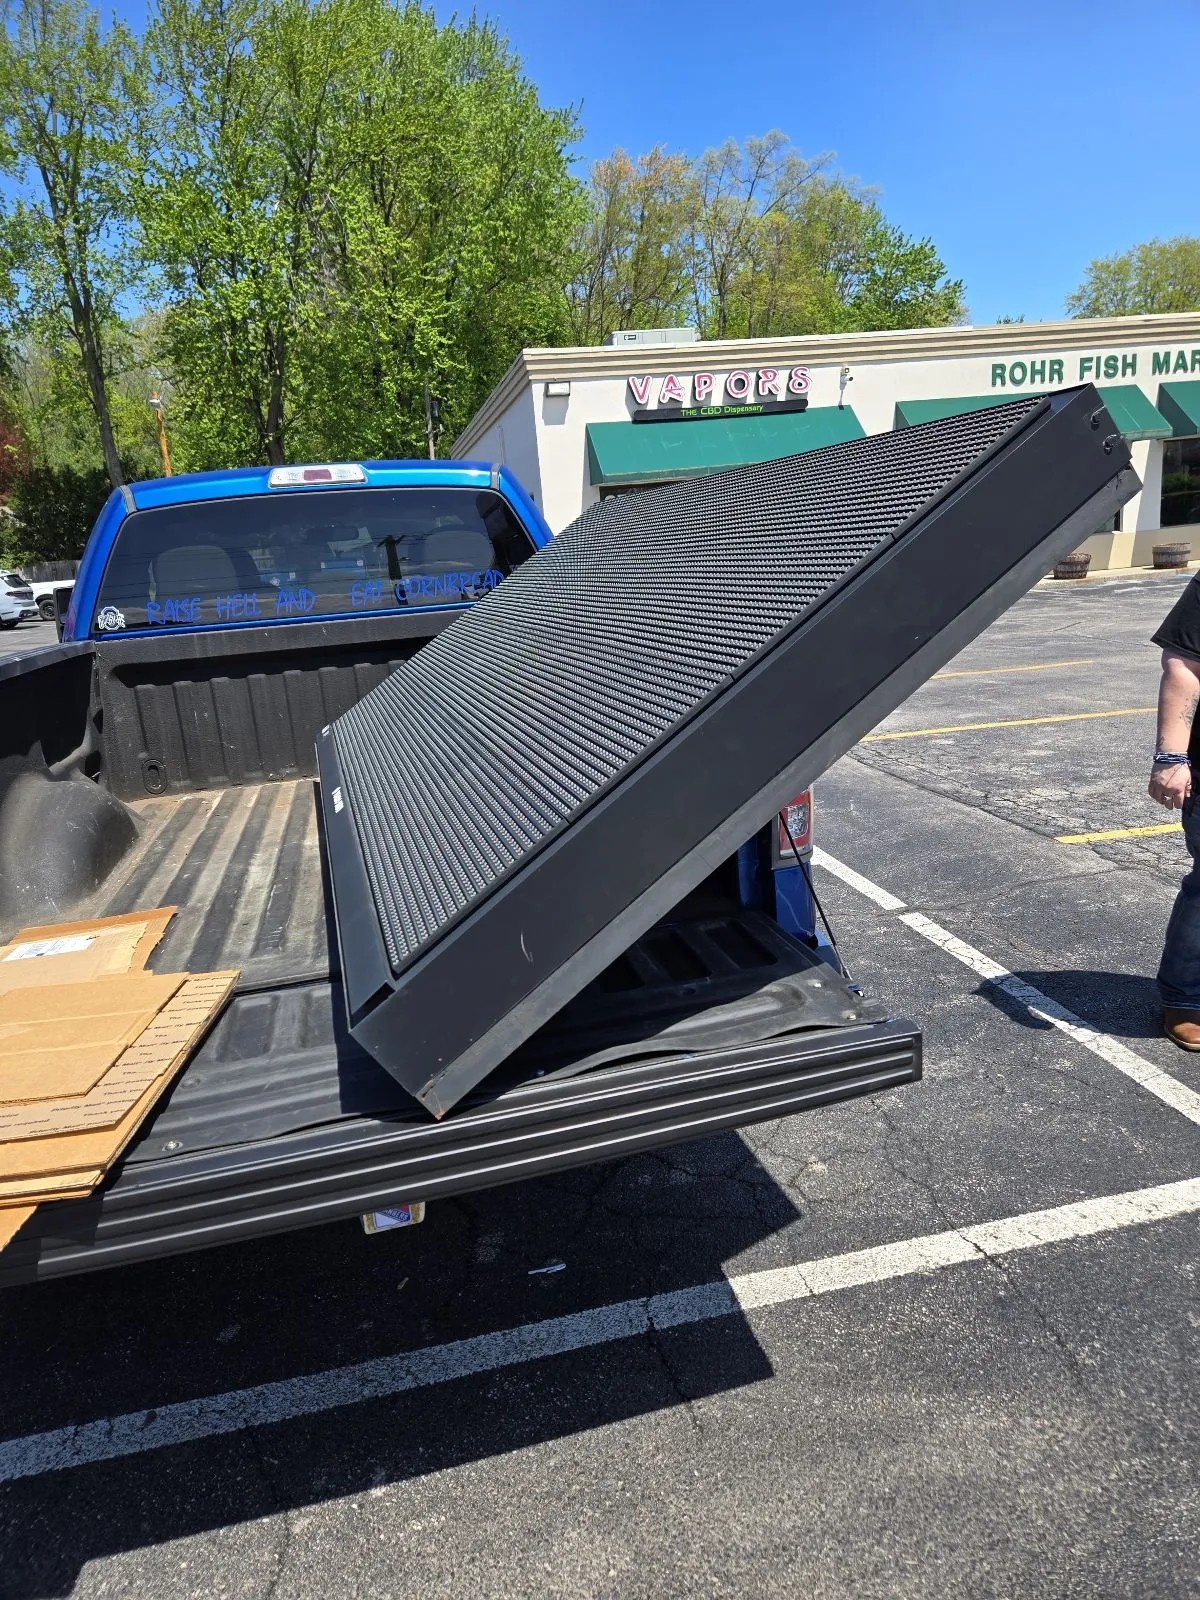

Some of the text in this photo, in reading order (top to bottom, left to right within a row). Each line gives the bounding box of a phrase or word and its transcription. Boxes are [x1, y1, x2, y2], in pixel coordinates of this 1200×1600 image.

[628, 366, 812, 404] VAPORS
[991, 350, 1200, 387] ROHR FISH MAR
[700, 406, 721, 415] CBD
[724, 404, 764, 414] Dispensary
[147, 597, 202, 625] RAISE
[216, 592, 261, 619] HELL
[276, 588, 316, 615] AND
[351, 580, 383, 607] EAT
[395, 568, 504, 601] CORNBREAD
